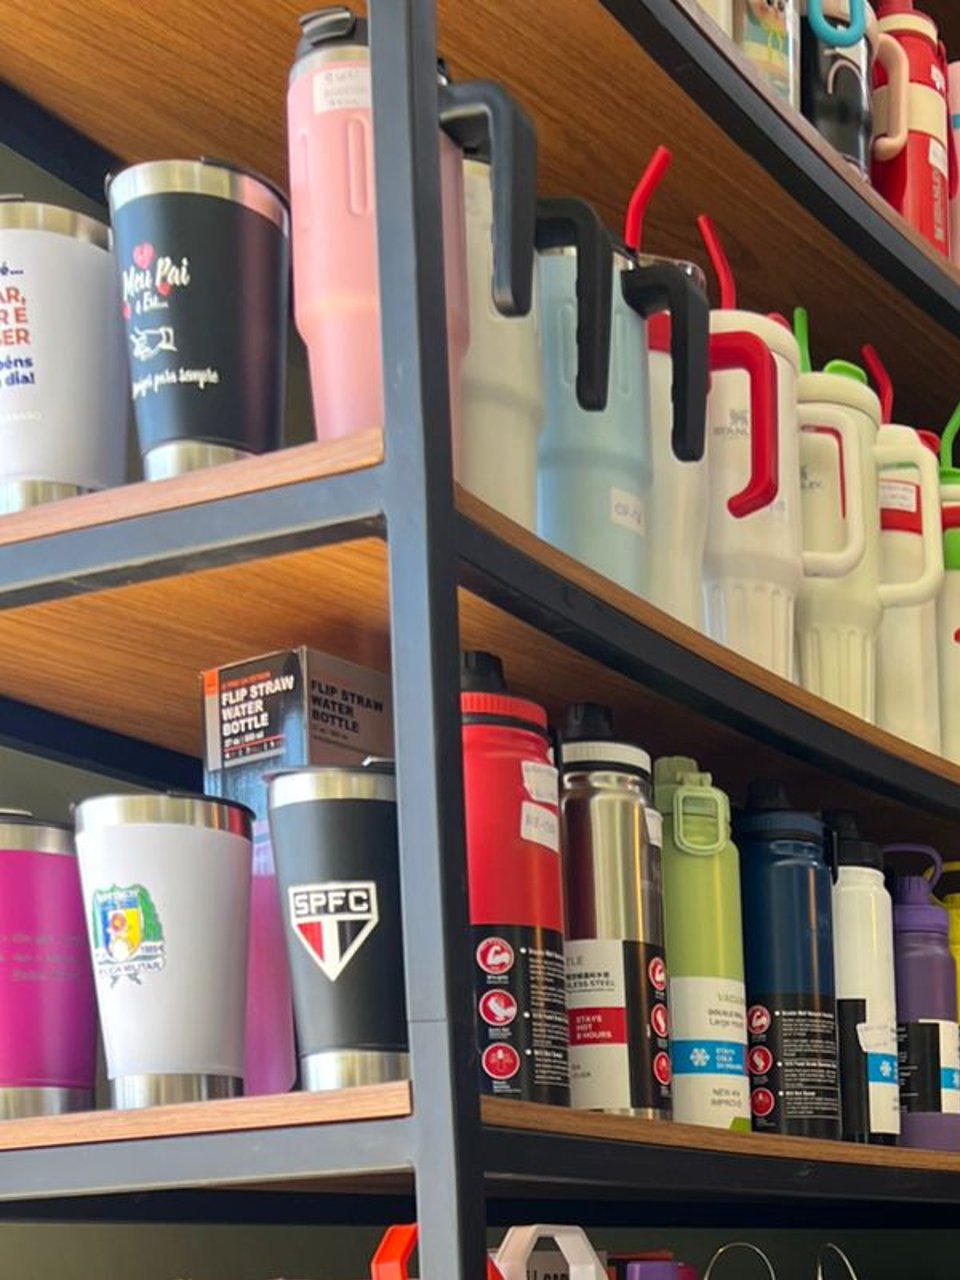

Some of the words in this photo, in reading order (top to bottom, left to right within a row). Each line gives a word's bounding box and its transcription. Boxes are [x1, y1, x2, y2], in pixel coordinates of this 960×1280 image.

[122, 265, 152, 301] Meu
[156, 256, 190, 287] Pai
[0, 286, 26, 306] AR,
[0, 328, 30, 346] ER
[221, 688, 248, 707] FLIP
[250, 675, 295, 700] STRAW
[311, 679, 339, 696] FLIP
[341, 688, 384, 714] STRAW
[221, 699, 264, 722] WATER
[311, 694, 354, 718] WATER
[222, 713, 270, 737] BOTTLE
[311, 708, 359, 734] BOTTLE
[293, 890, 370, 916] SPFC
